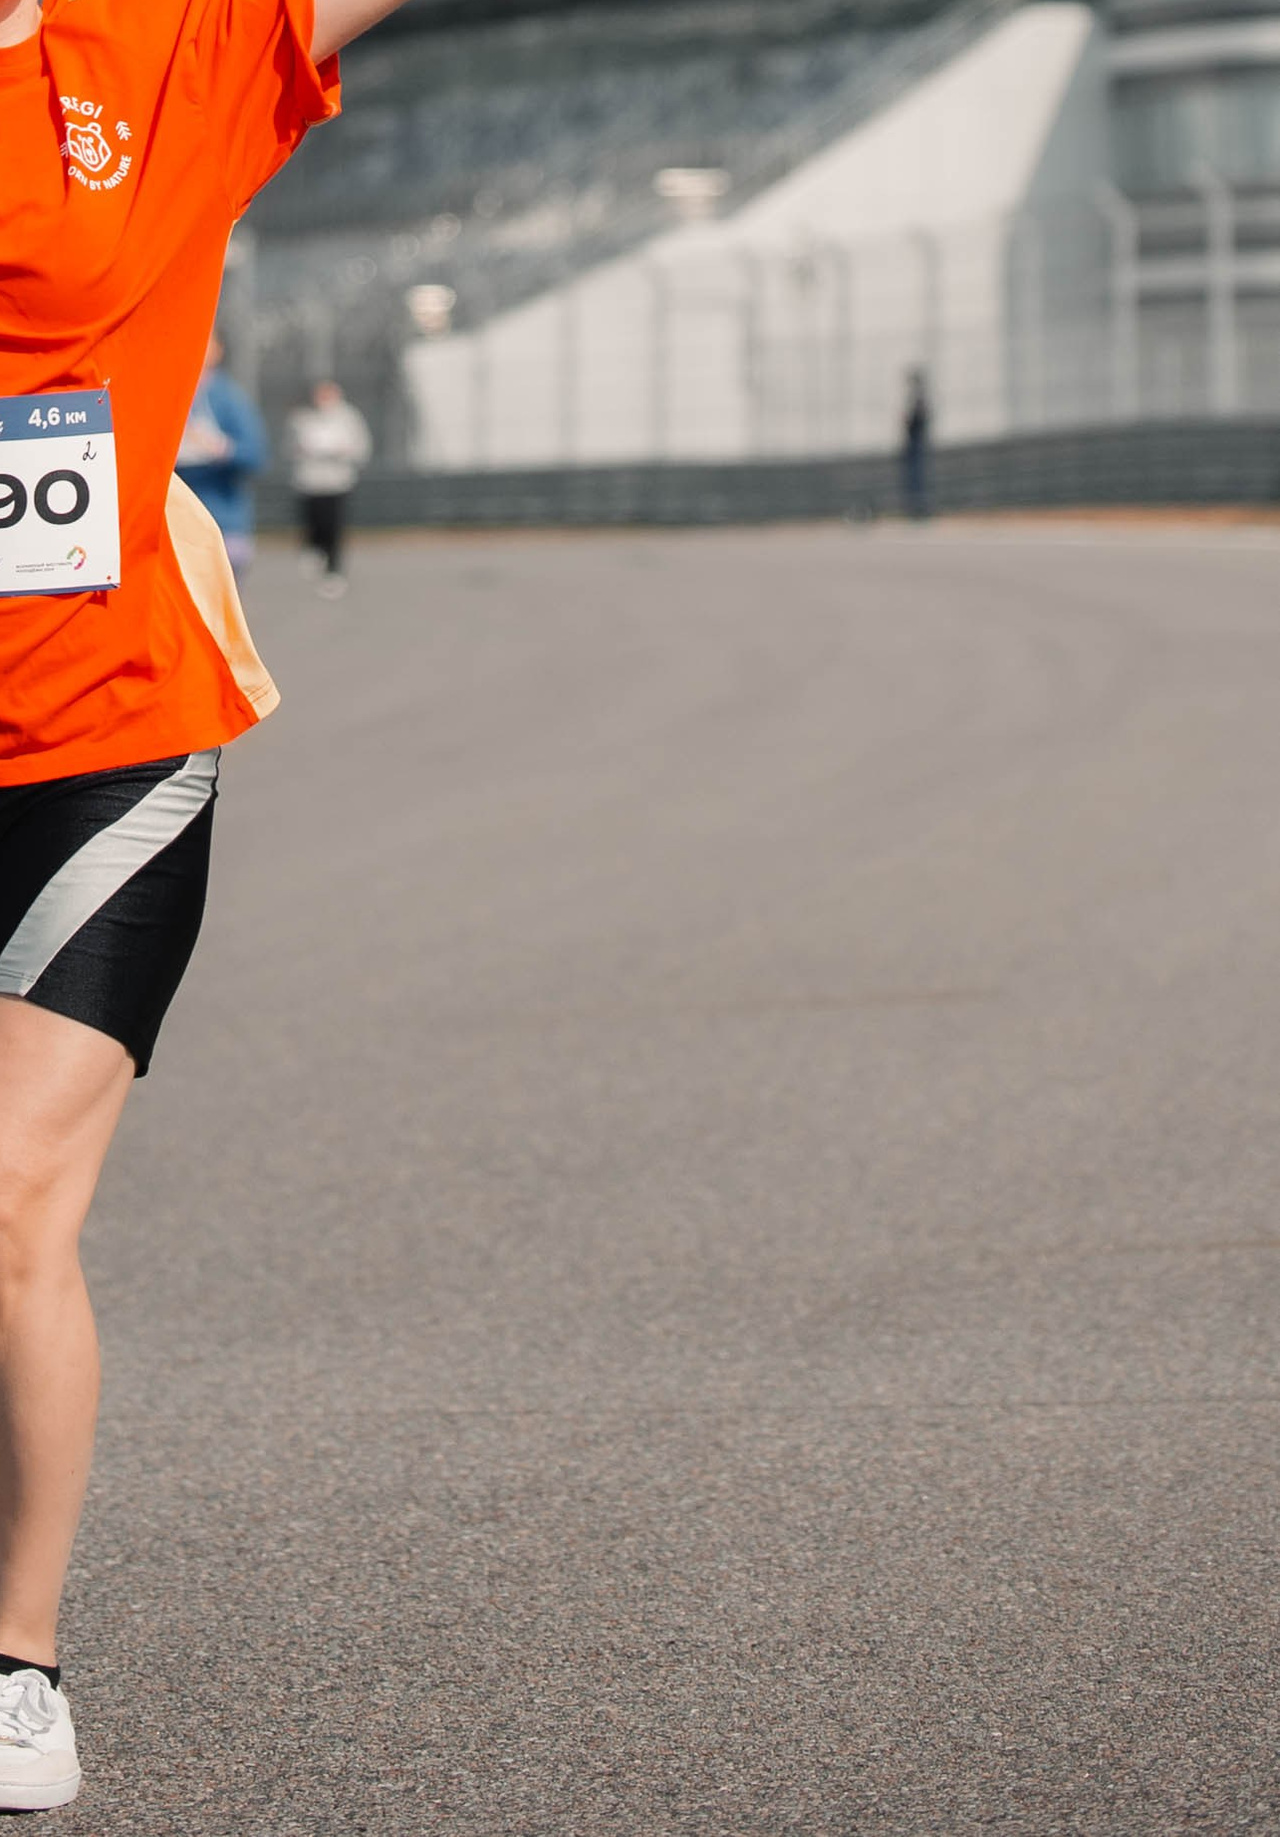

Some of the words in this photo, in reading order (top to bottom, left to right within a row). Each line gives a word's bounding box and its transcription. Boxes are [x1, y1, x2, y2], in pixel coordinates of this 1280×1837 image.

[89, 180, 101, 191] BY
[102, 154, 132, 189] NATURE
[28, 407, 60, 429] 4,6
